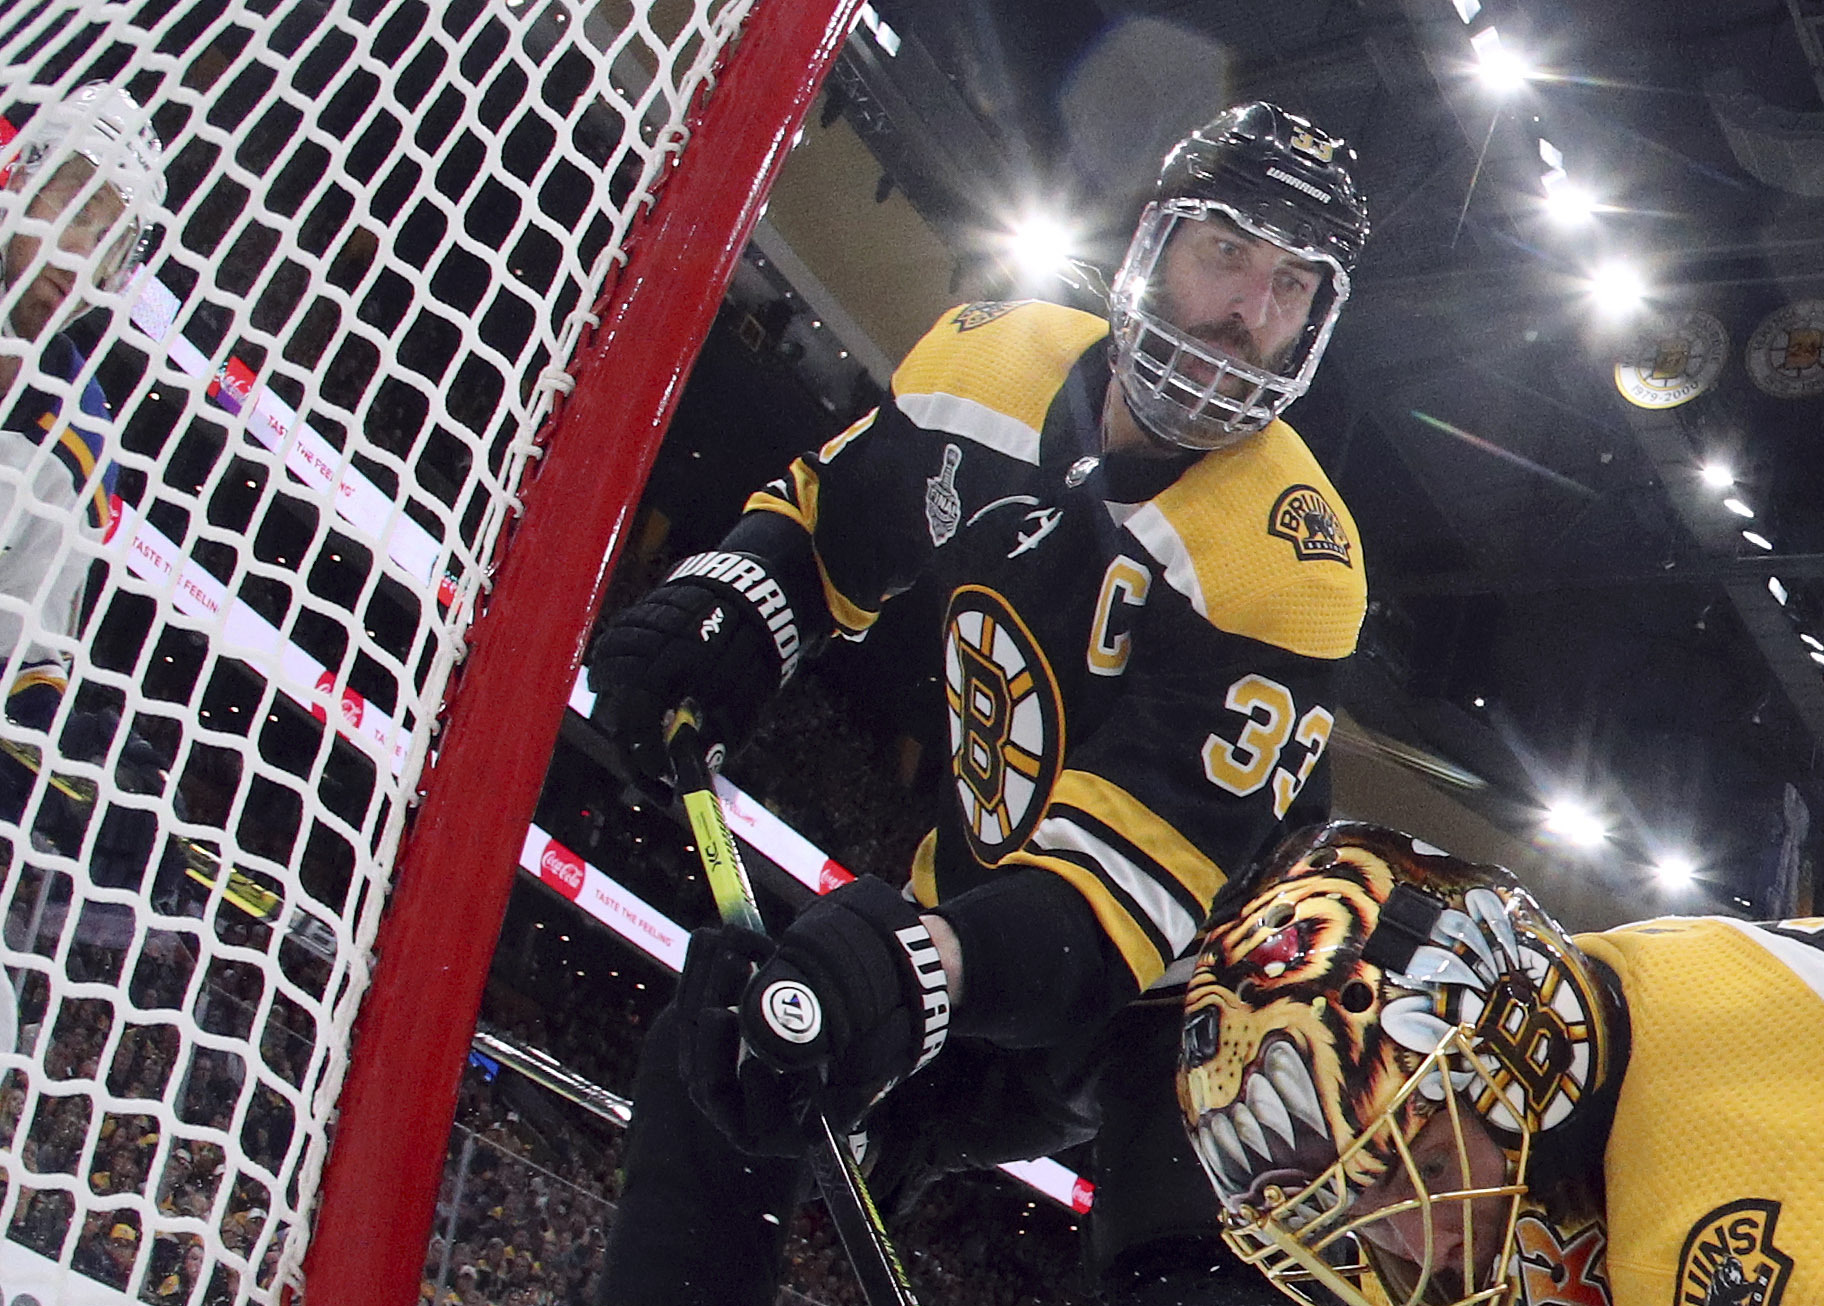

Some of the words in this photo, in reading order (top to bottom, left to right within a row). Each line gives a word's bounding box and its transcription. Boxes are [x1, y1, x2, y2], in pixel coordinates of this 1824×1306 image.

[1265, 166, 1333, 204] WARRIOR
[1631, 380, 1700, 402] 1979-2000
[131, 535, 162, 568] TASTE
[183, 578, 219, 615] FEELIN
[665, 550, 801, 690] WARRIOR
[1087, 553, 1152, 677] C
[1201, 672, 1335, 821] 33
[541, 849, 585, 889] Coca-Cola
[595, 888, 621, 915] TASTE
[621, 906, 638, 927] THE
[638, 917, 672, 948] FEELING
